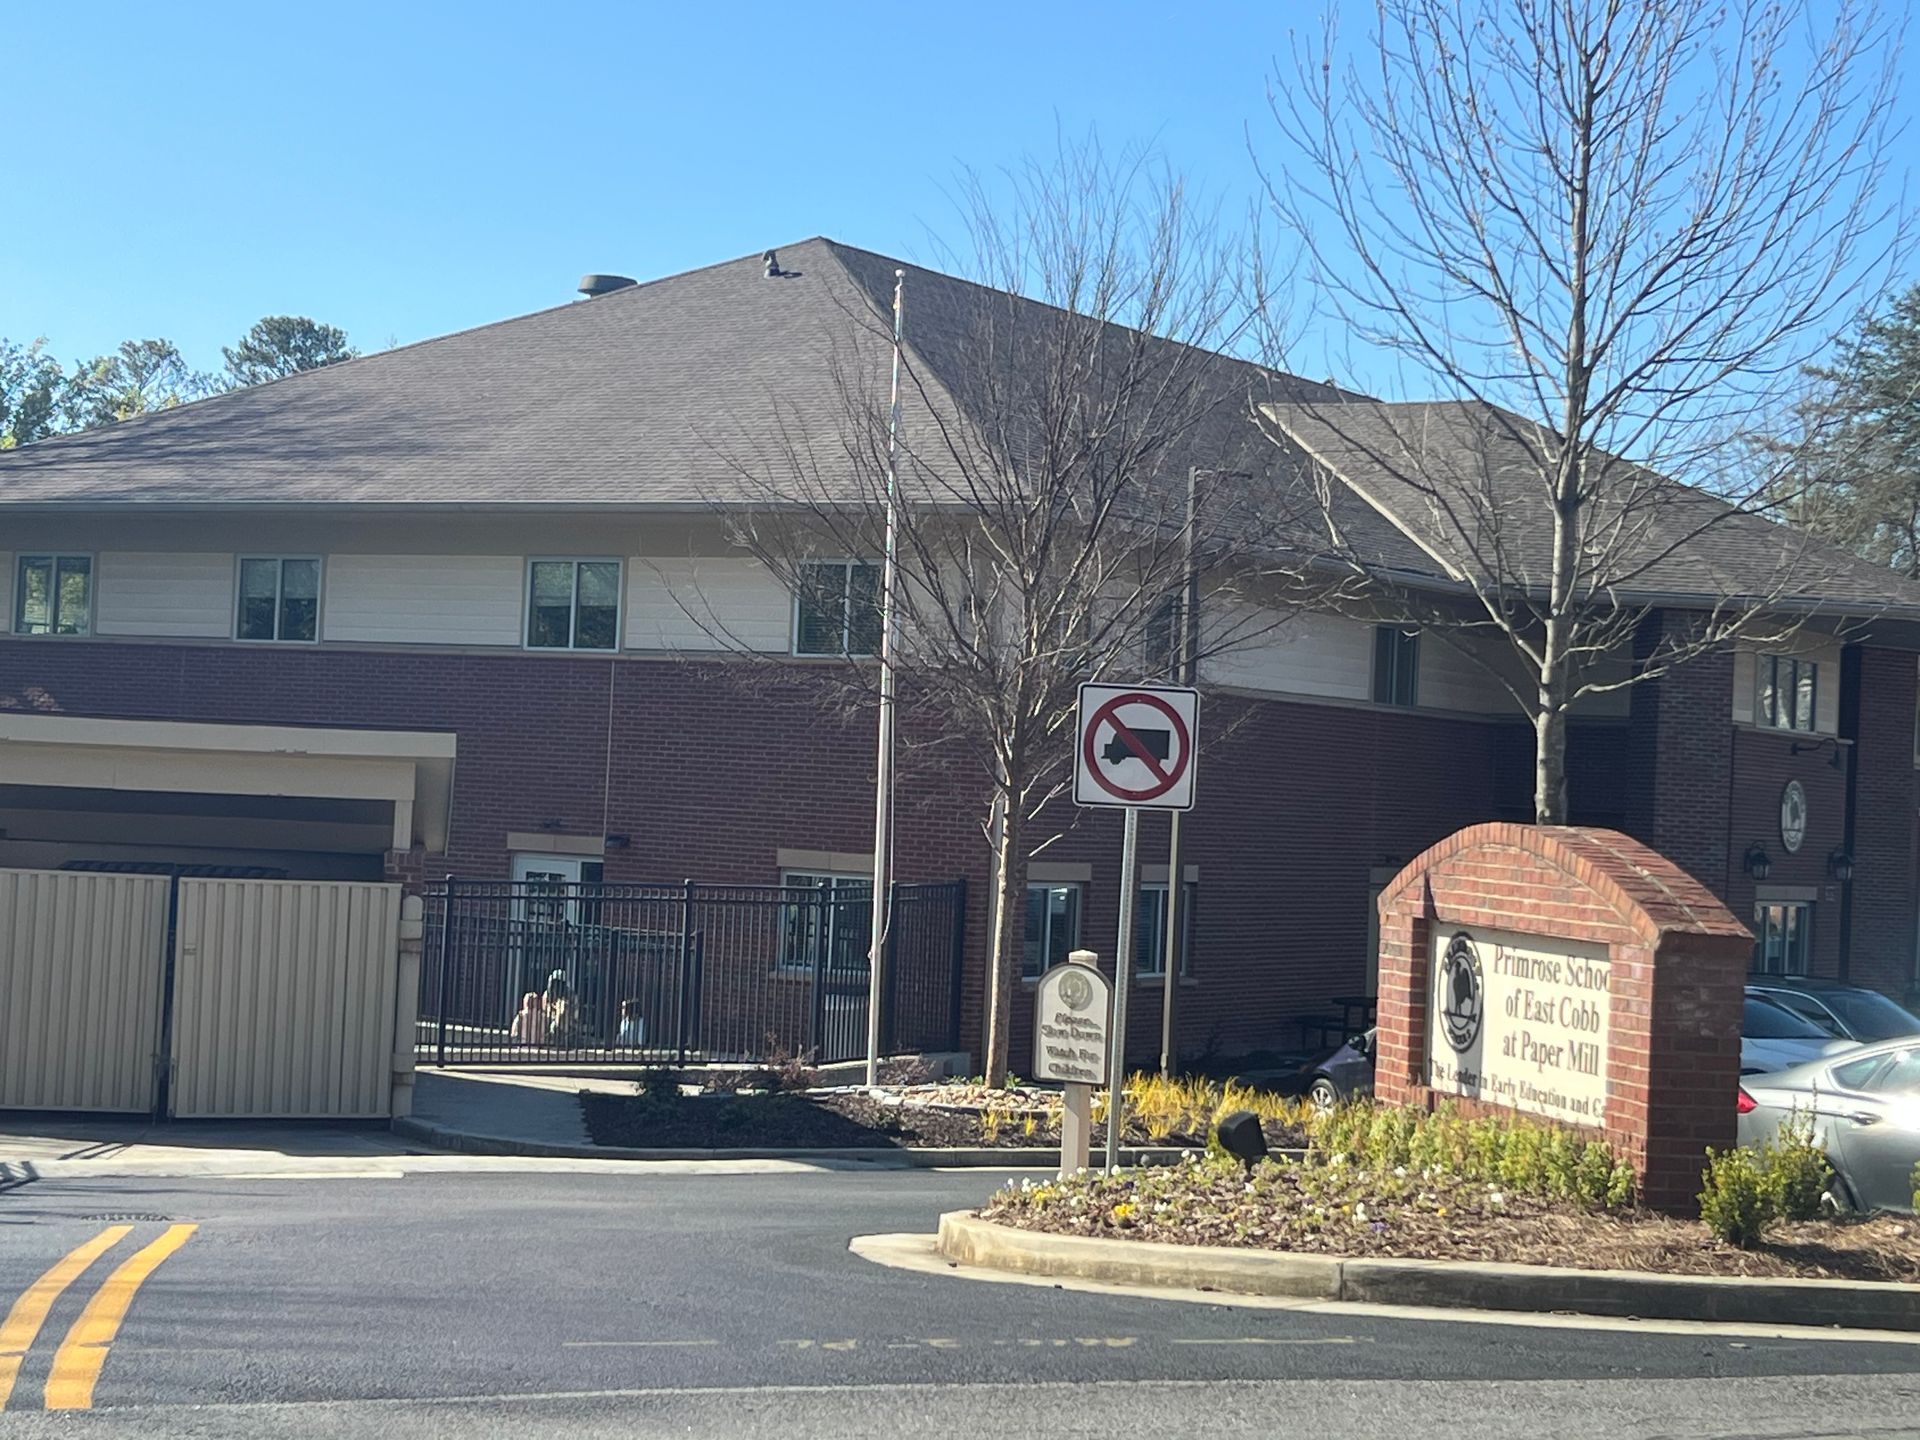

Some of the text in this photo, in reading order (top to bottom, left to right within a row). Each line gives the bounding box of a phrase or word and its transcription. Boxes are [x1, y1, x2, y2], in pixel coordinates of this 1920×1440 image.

[1494, 944, 1561, 984] Primrose
[1505, 988, 1600, 1034] of East Cobb
[1503, 1030, 1599, 1077] at Paper Mill
[1491, 1073, 1515, 1096] Early
[1571, 1096, 1589, 1115] and
